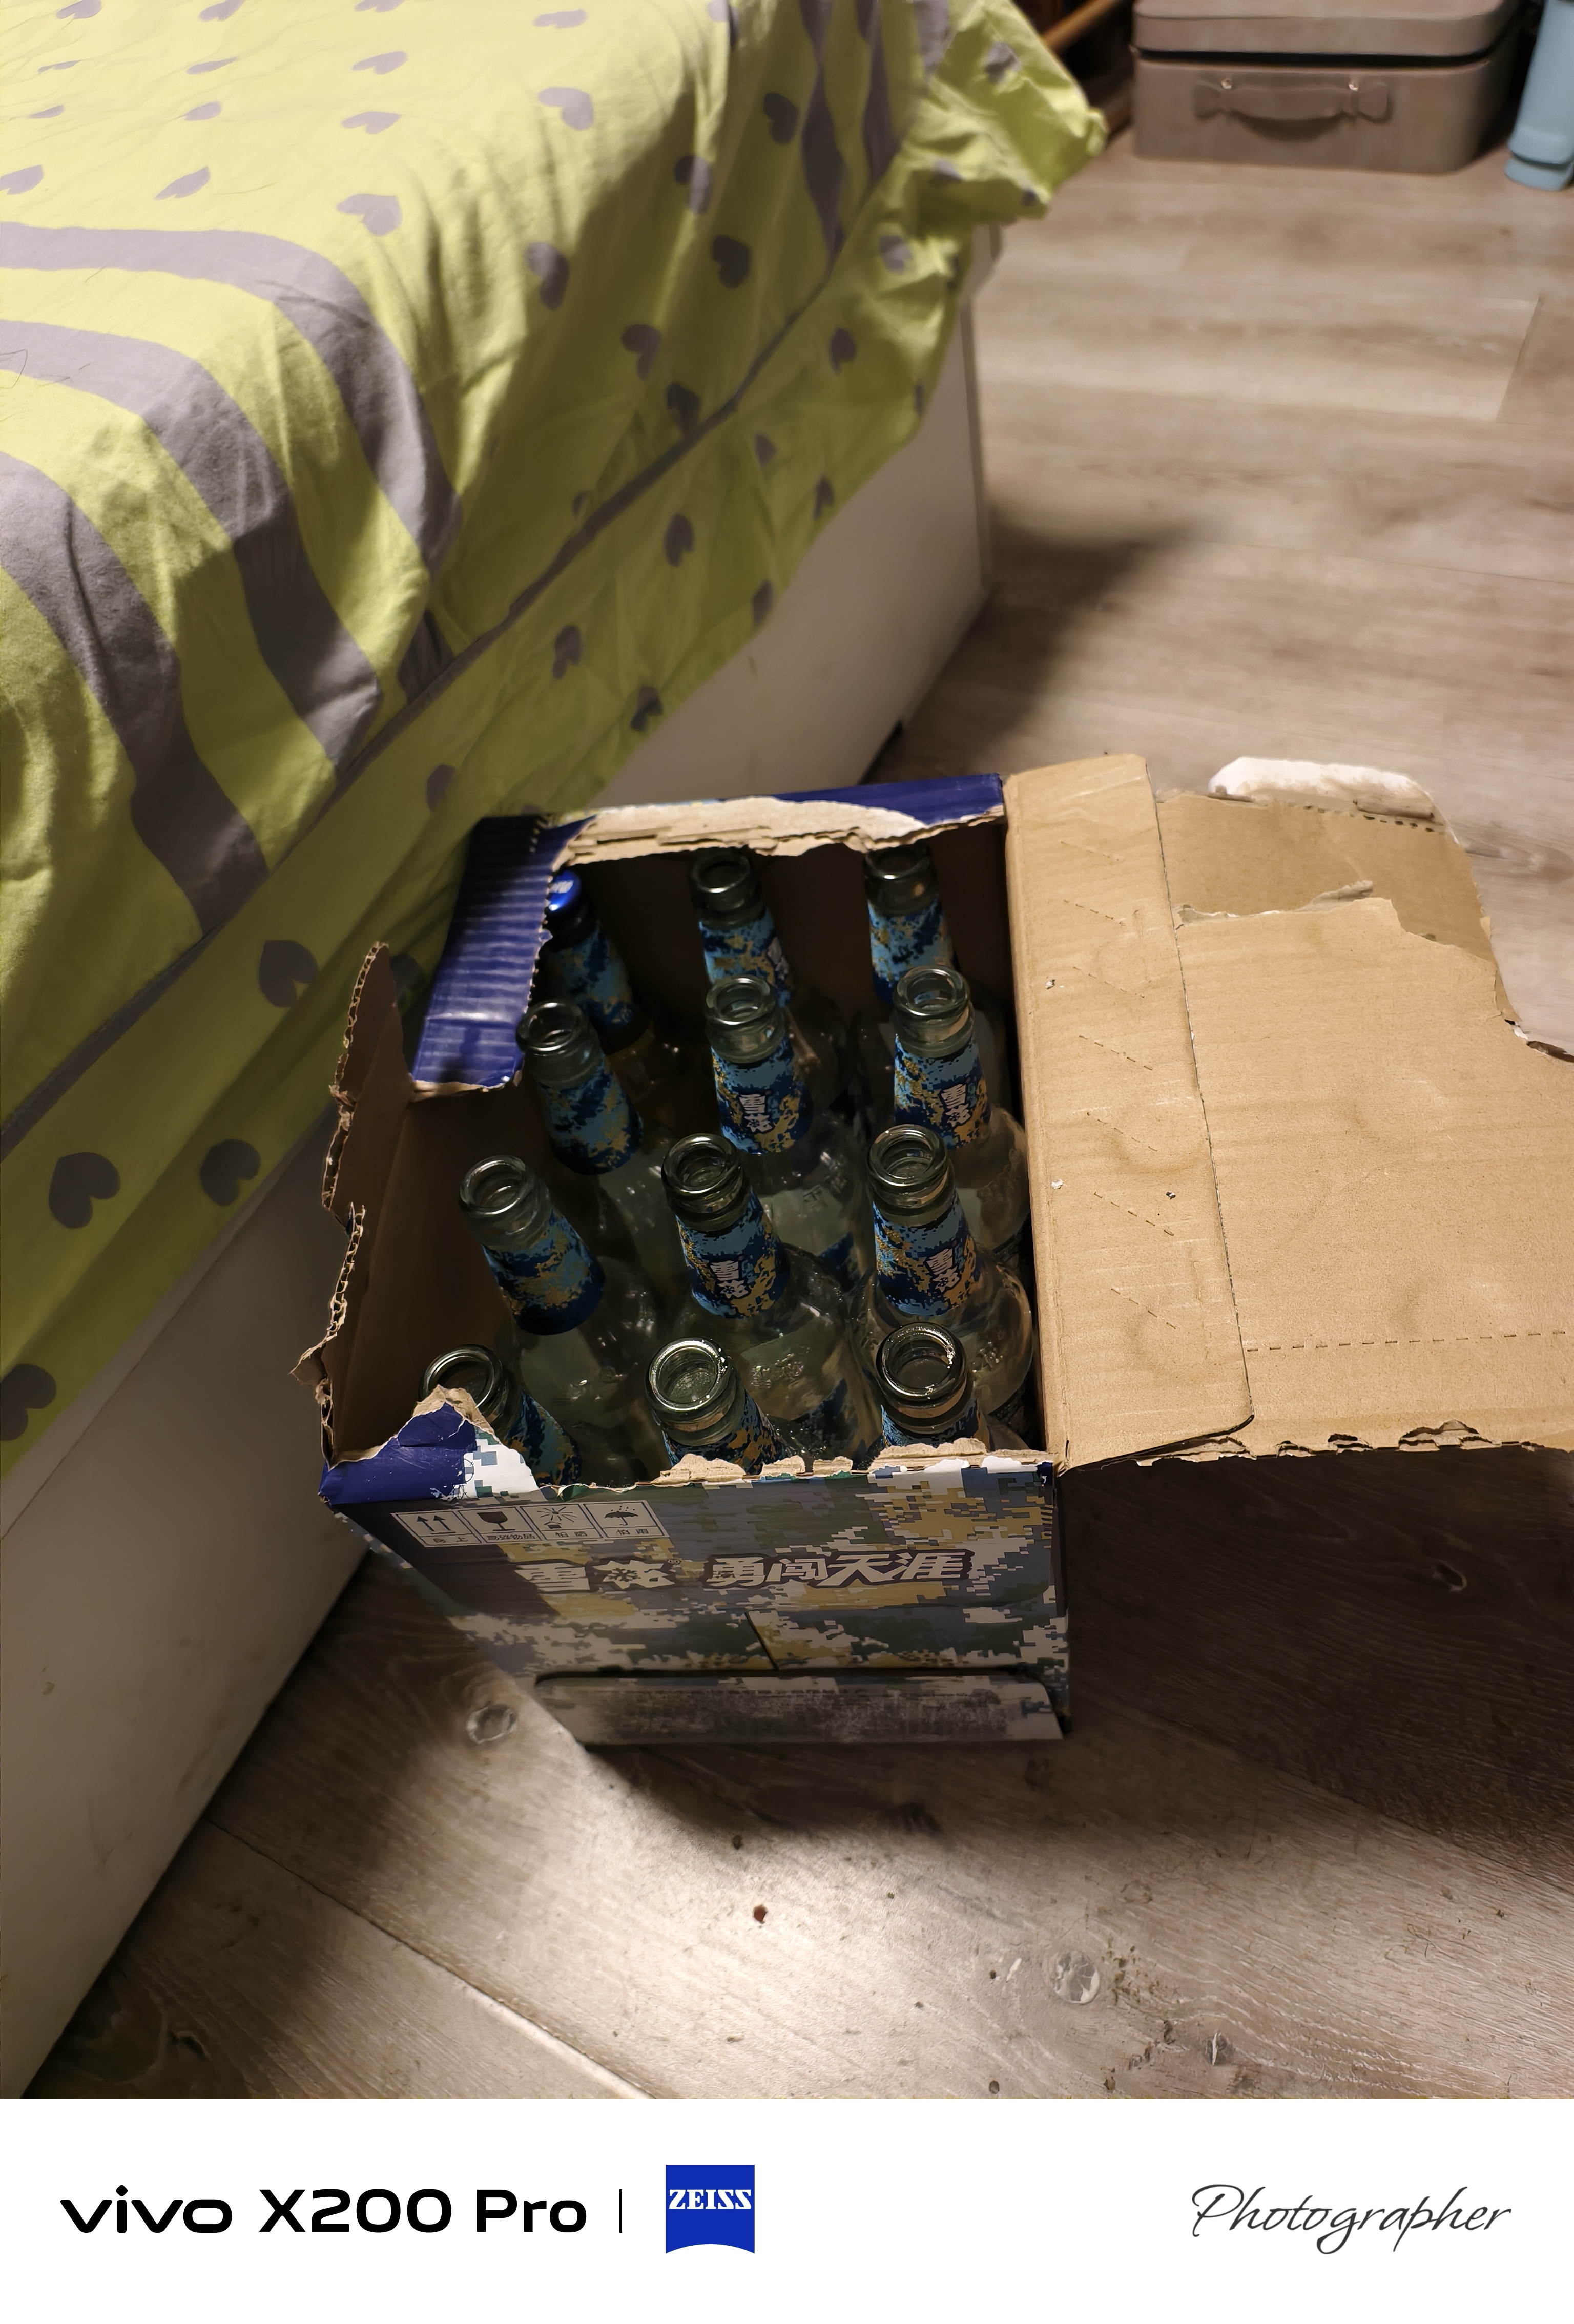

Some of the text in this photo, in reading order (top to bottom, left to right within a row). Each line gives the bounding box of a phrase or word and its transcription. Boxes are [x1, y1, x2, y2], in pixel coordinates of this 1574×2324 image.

[738, 1093, 771, 1133] 雪花
[941, 1083, 974, 1126] 雪花
[710, 1260, 747, 1299] 雪花
[926, 1248, 960, 1290] 雪花
[514, 1552, 965, 1592] 雪花 勇闯天涯
